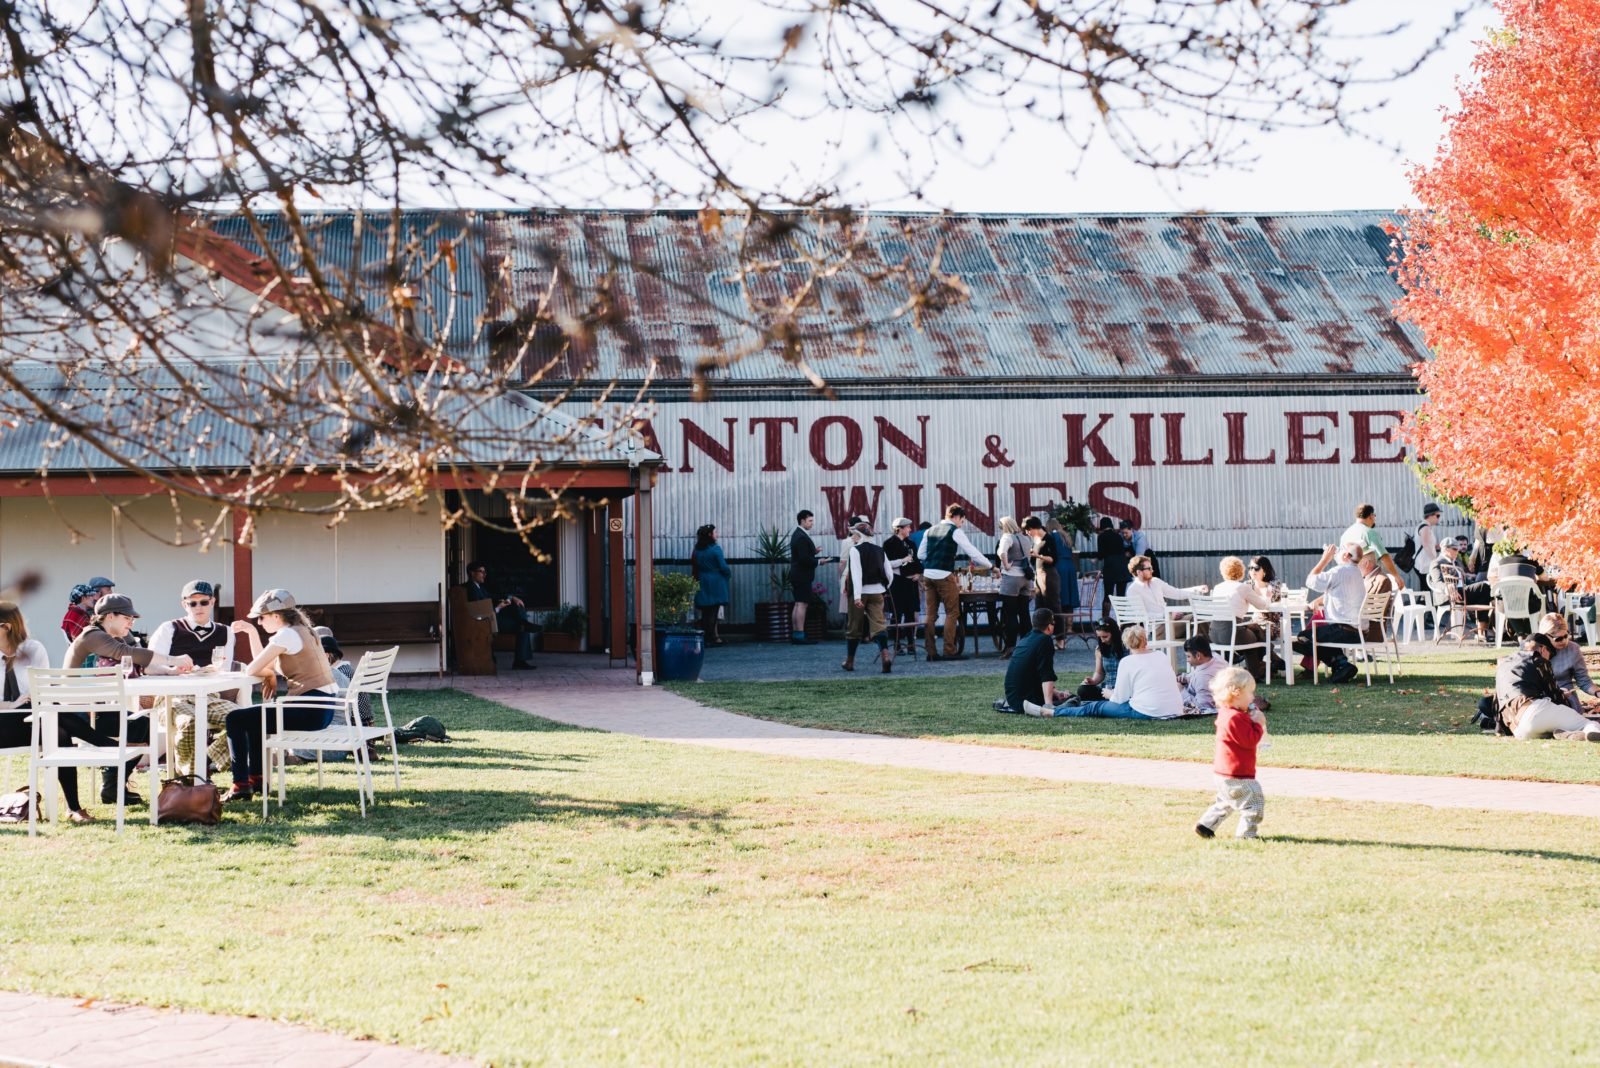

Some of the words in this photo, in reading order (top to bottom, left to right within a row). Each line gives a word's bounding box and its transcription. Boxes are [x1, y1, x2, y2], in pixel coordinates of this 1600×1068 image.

[981, 434, 1015, 468] &
[1062, 411, 1429, 468] KILLEE
[821, 481, 1142, 540] WINES
